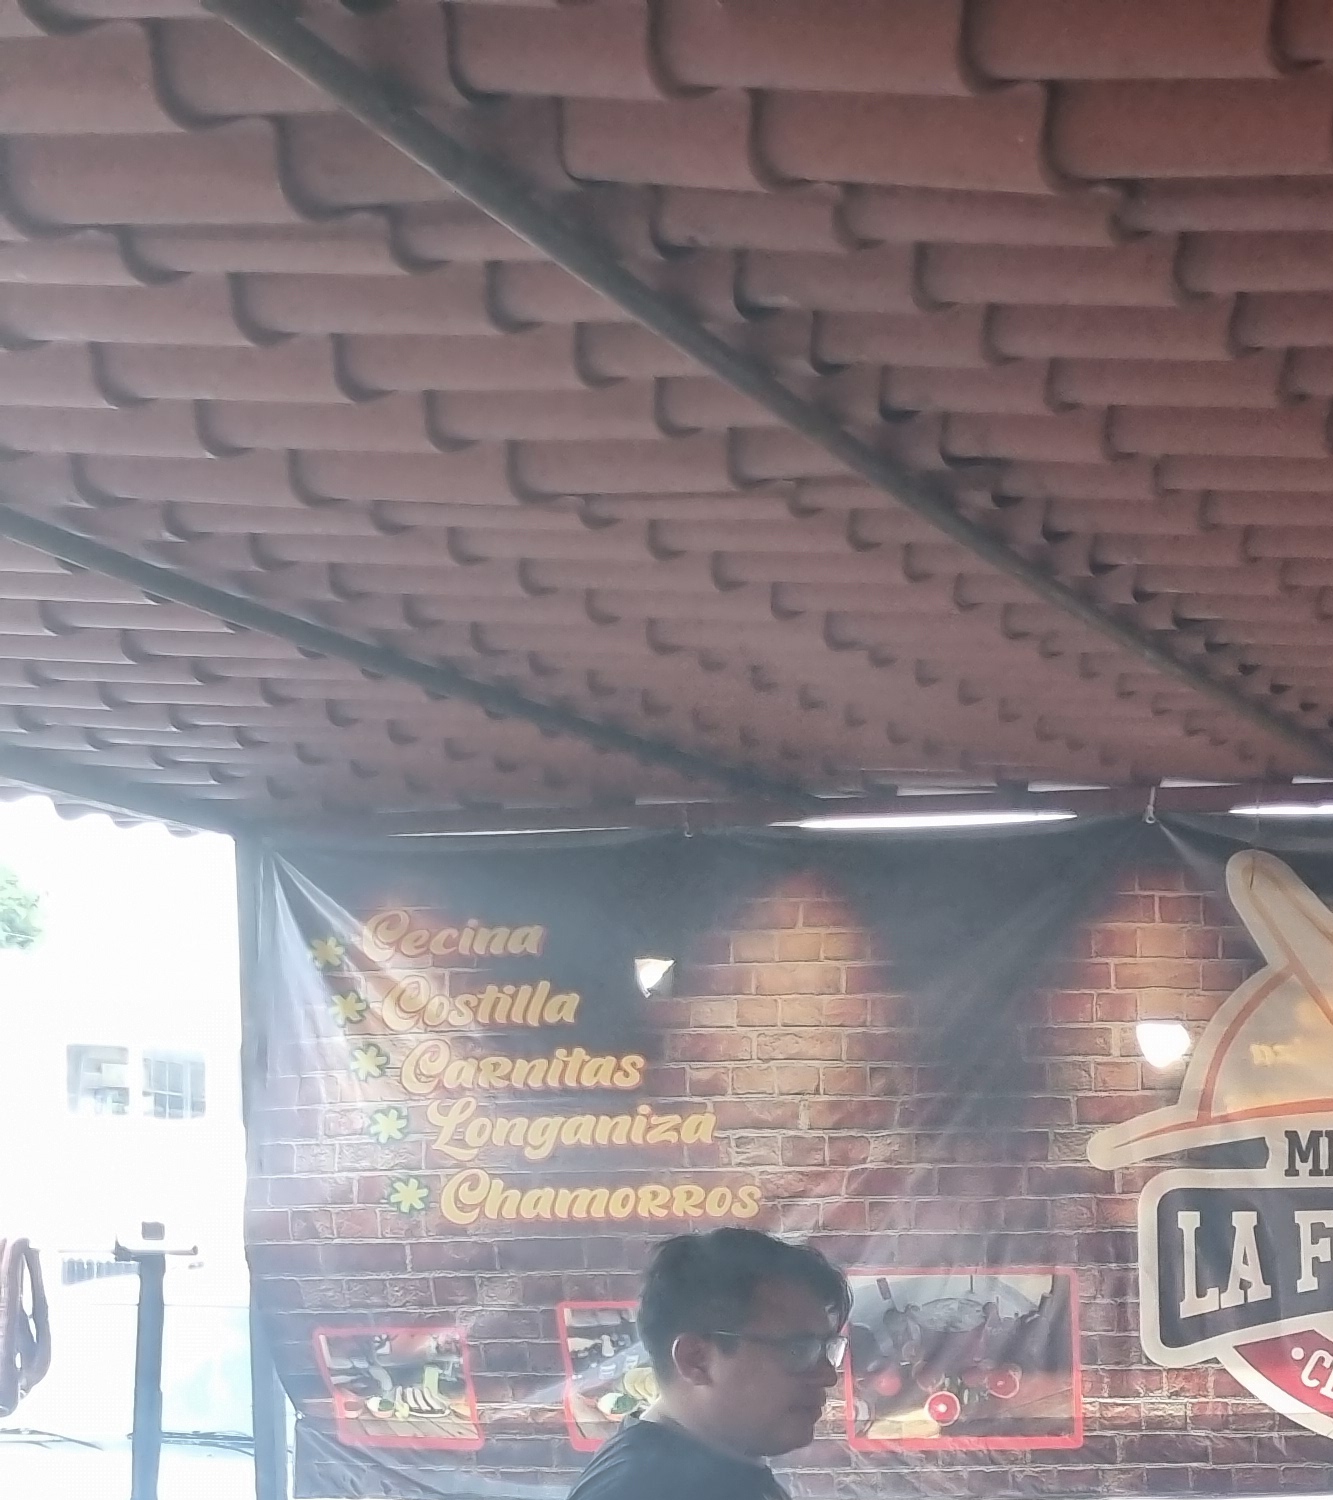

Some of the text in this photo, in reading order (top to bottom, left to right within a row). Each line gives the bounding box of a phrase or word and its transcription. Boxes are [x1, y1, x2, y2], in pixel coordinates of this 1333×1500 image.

[362, 910, 544, 962] Cecina
[382, 975, 580, 1031] Costilla
[400, 1039, 645, 1094] Carnitas
[427, 1097, 717, 1161] Longaniza
[441, 1168, 762, 1224] Chamorros
[1177, 1210, 1271, 1319] LA
